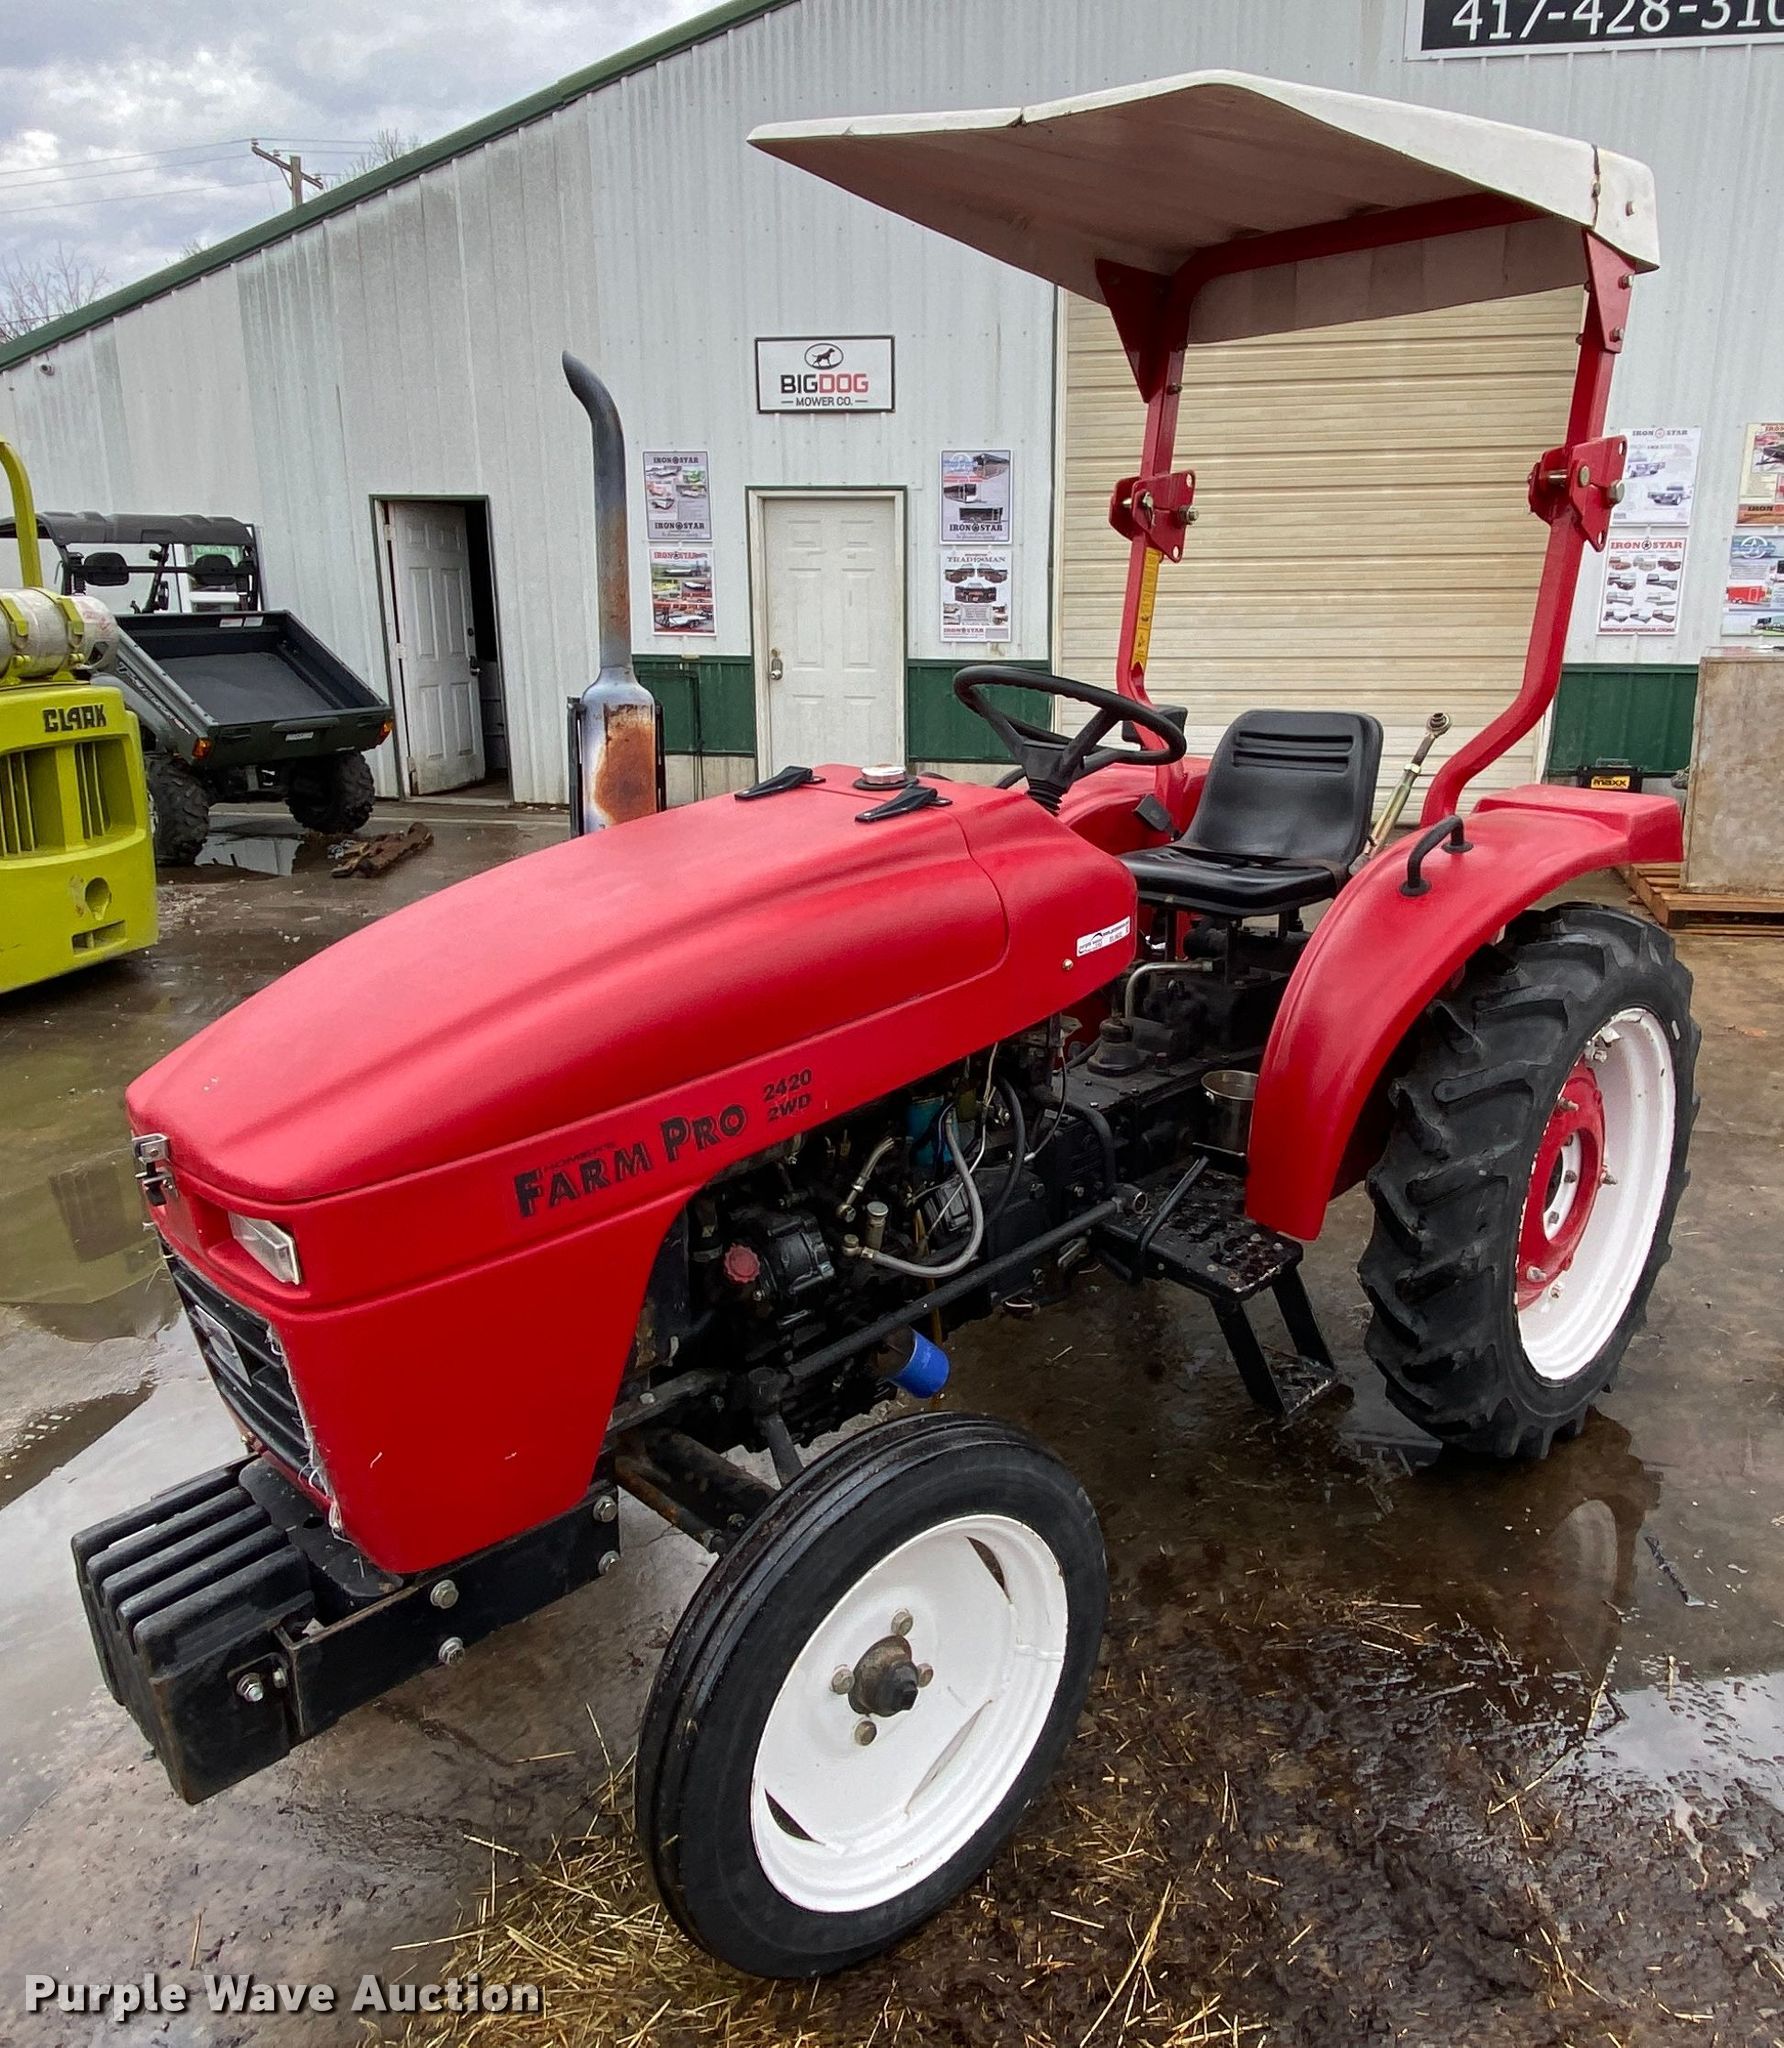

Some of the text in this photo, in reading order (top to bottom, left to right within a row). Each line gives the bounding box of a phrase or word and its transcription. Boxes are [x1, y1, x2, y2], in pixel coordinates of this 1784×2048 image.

[780, 373, 869, 394] BIGDOG
[796, 396, 853, 406] MOWER CO.
[1610, 541, 1682, 549] IRON STAR
[42, 704, 107, 733] CLARK
[763, 1067, 813, 1102] 2420
[768, 1093, 811, 1122] 2WD
[513, 1103, 748, 1218] FARM PRO
